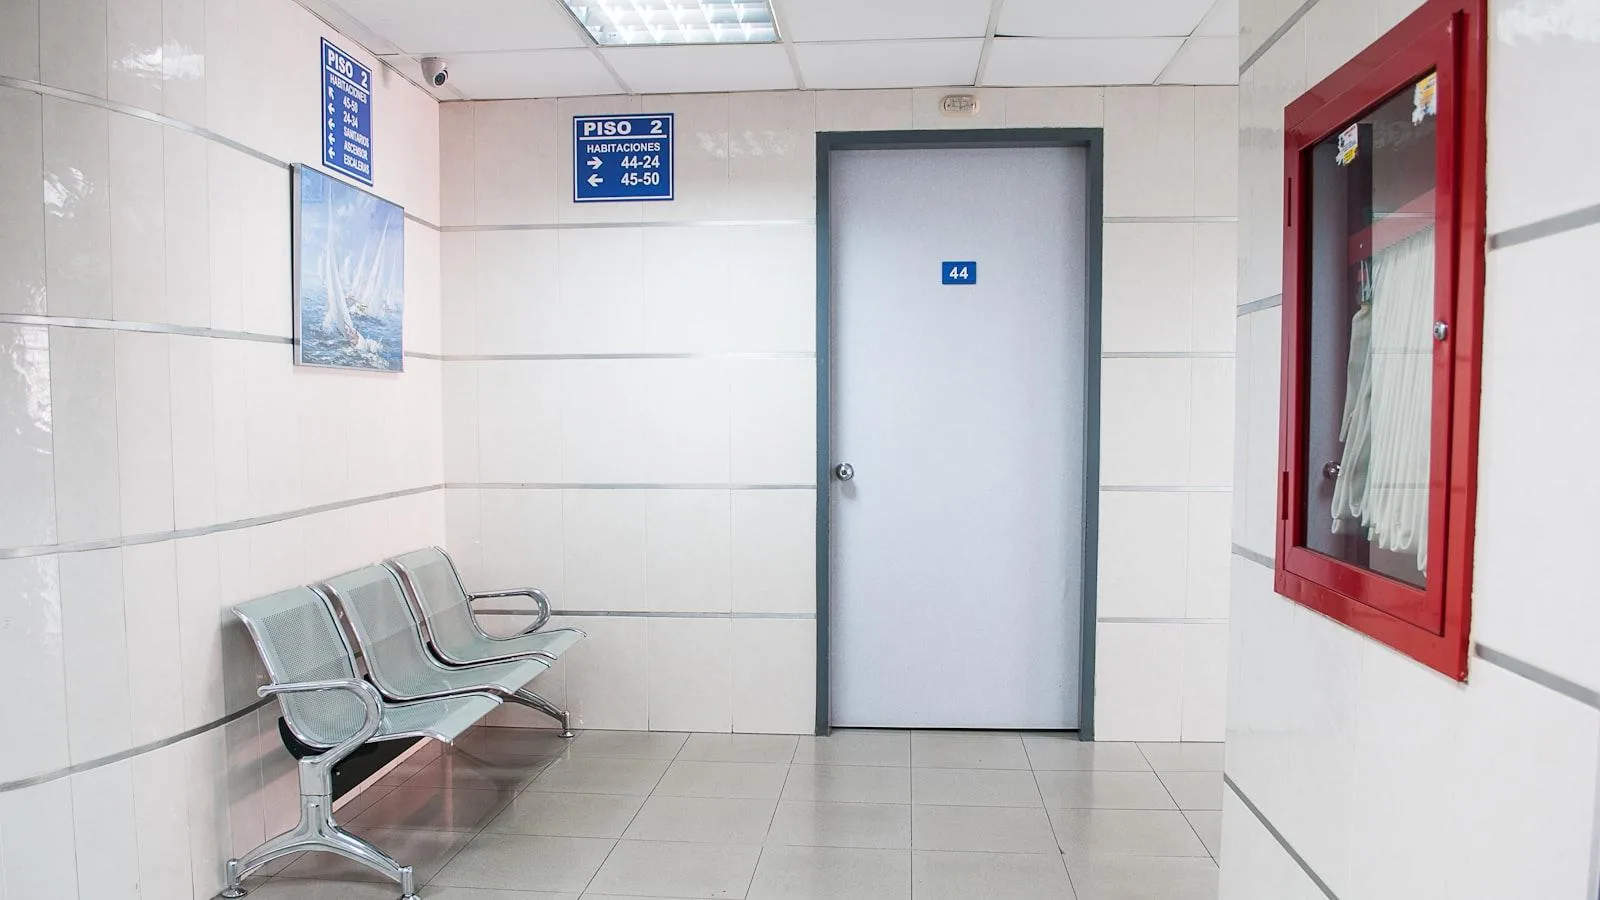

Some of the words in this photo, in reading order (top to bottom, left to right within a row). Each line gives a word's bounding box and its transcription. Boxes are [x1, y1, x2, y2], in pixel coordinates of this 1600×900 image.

[328, 49, 353, 78] PISO
[361, 71, 368, 89] 2
[330, 73, 367, 104] HABITACIONES
[343, 96, 358, 113] 45-50
[343, 111, 358, 128] 24-34
[584, 121, 632, 136] PISO
[650, 120, 663, 134] 2
[344, 126, 369, 148] SANITARIOS
[344, 140, 368, 160] ASCENSOR
[586, 143, 661, 153] HABITACIONES
[344, 154, 369, 175] ESCALERAS
[621, 155, 660, 169] 44-24
[621, 172, 660, 186] 45-50
[949, 266, 969, 280] 44
